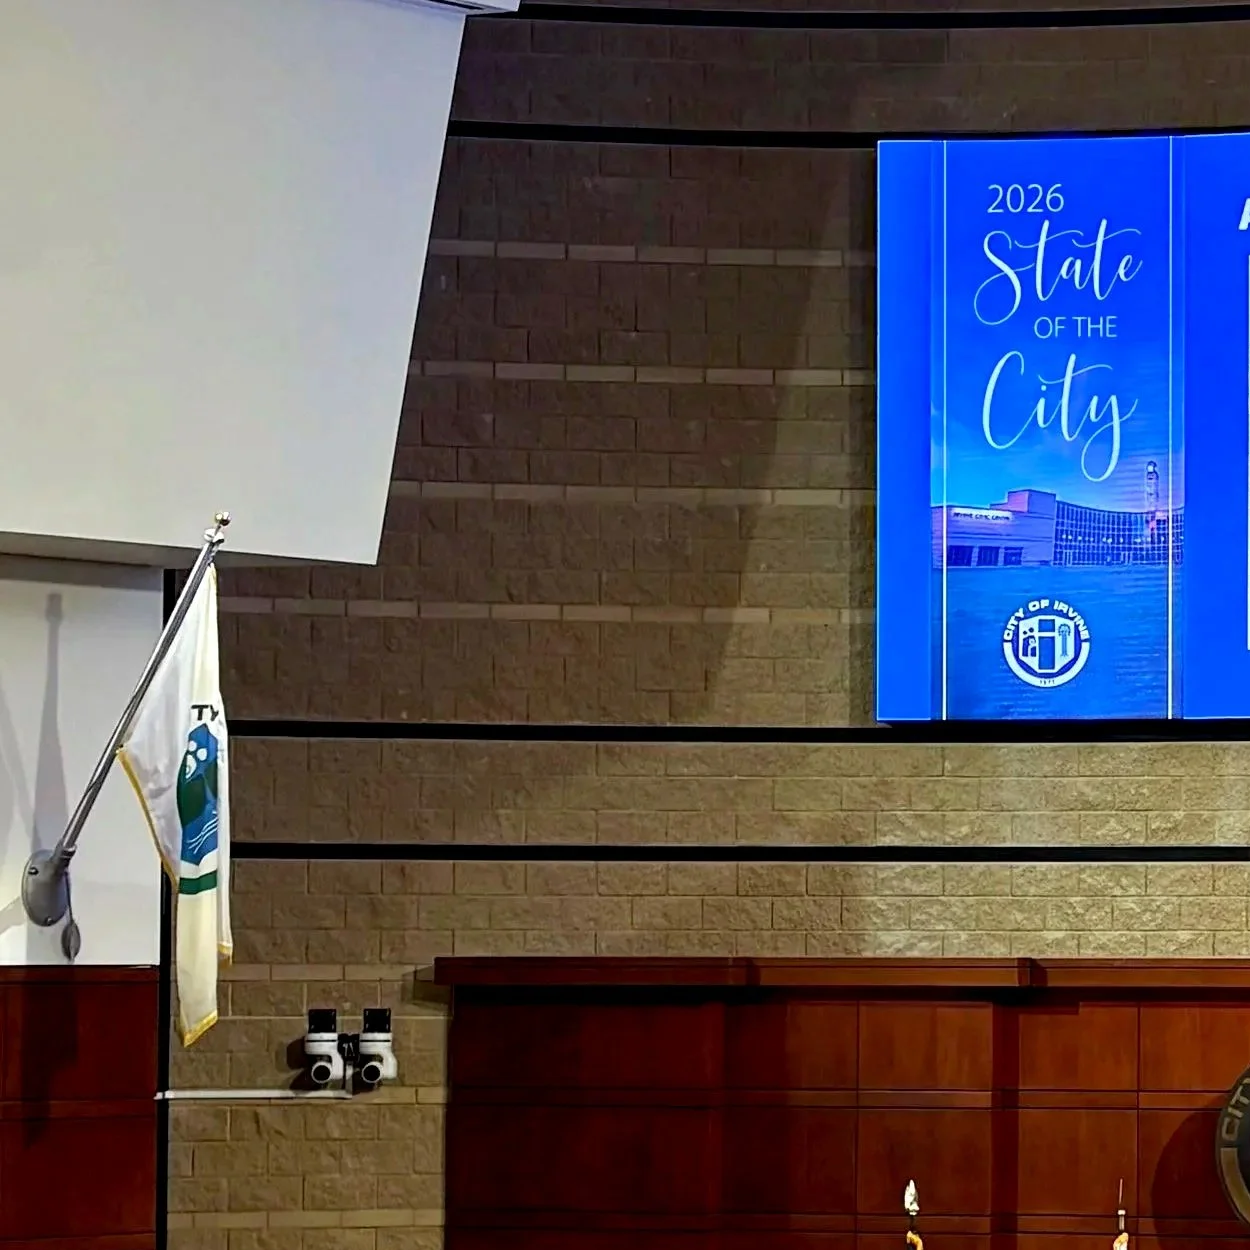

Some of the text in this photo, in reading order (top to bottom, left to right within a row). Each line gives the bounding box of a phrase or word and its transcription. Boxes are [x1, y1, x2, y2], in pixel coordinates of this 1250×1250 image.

[987, 183, 1066, 214] 2026
[973, 218, 1143, 326] State
[1033, 315, 1118, 339] OF THE
[982, 350, 1139, 482] City
[1003, 599, 1090, 641] CITY OF IRVINE
[190, 704, 219, 721] TY
